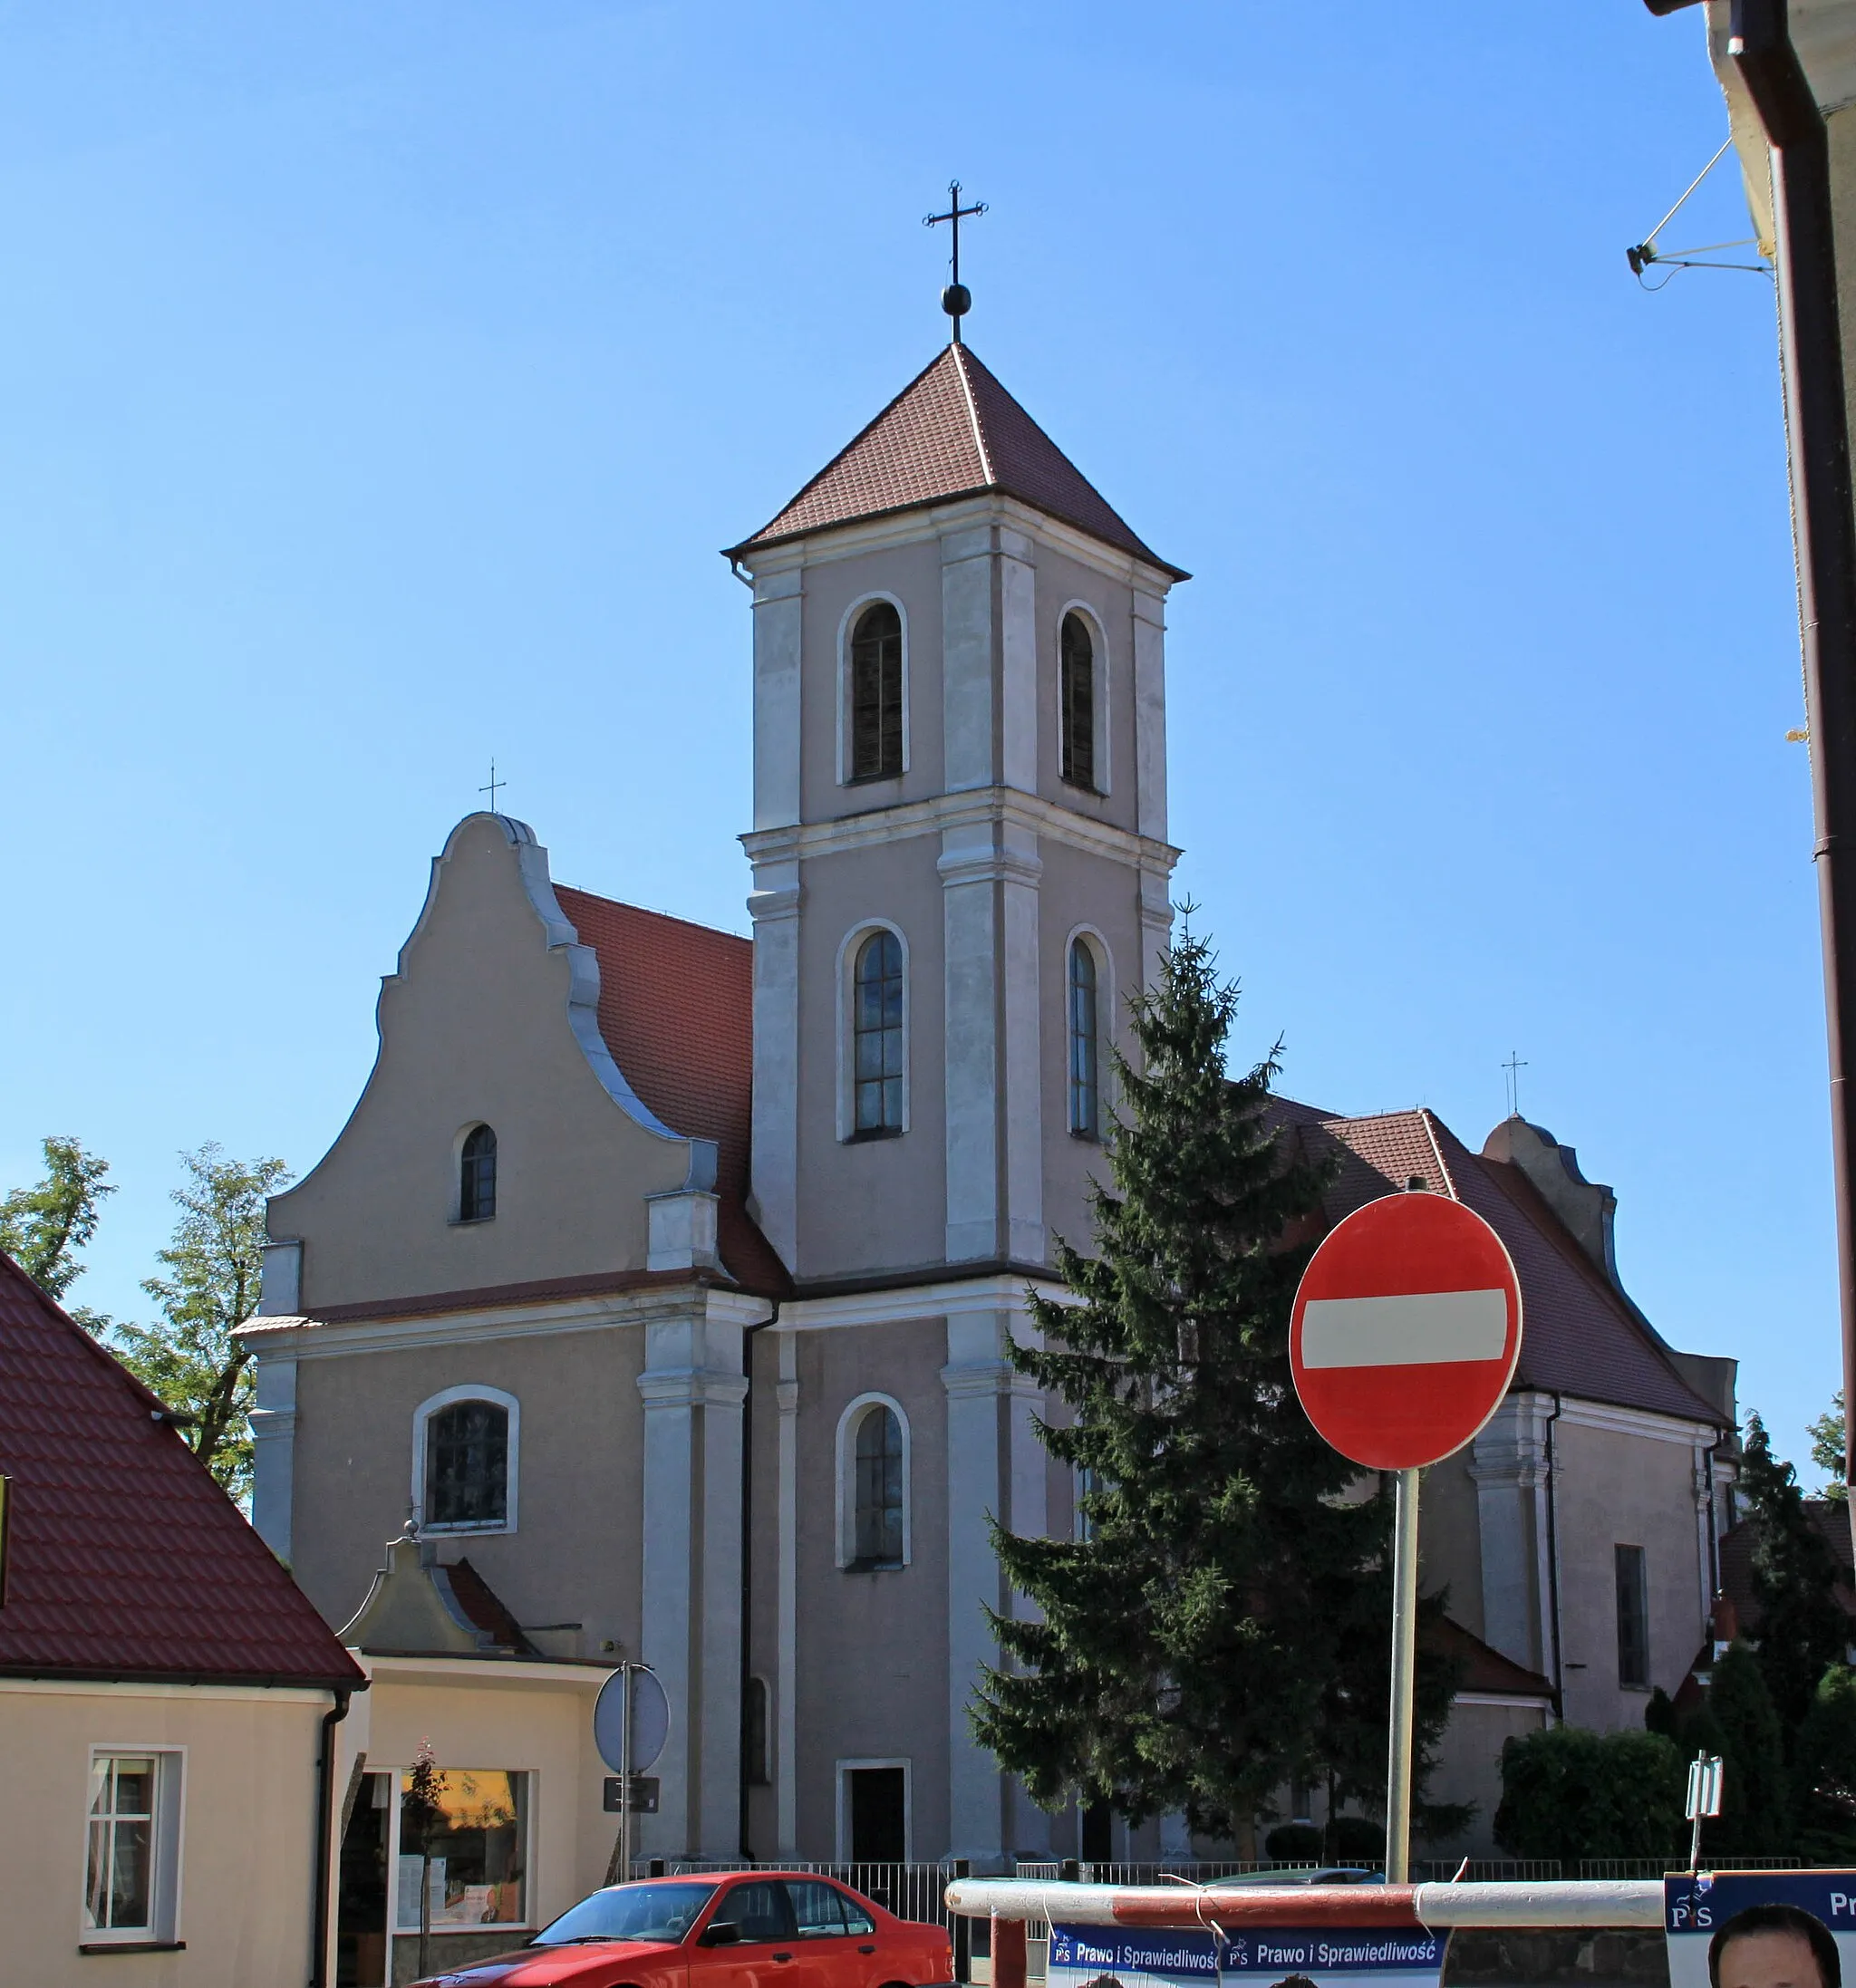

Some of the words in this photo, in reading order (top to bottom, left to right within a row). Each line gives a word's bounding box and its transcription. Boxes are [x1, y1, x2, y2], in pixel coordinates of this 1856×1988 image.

[1077, 1943, 1114, 1964] Prawo
[1116, 1945, 1120, 1963] i
[1257, 1945, 1305, 1964] Prawo
[1309, 1944, 1314, 1963] i
[1318, 1939, 1436, 1967] Sprawiedliwość
